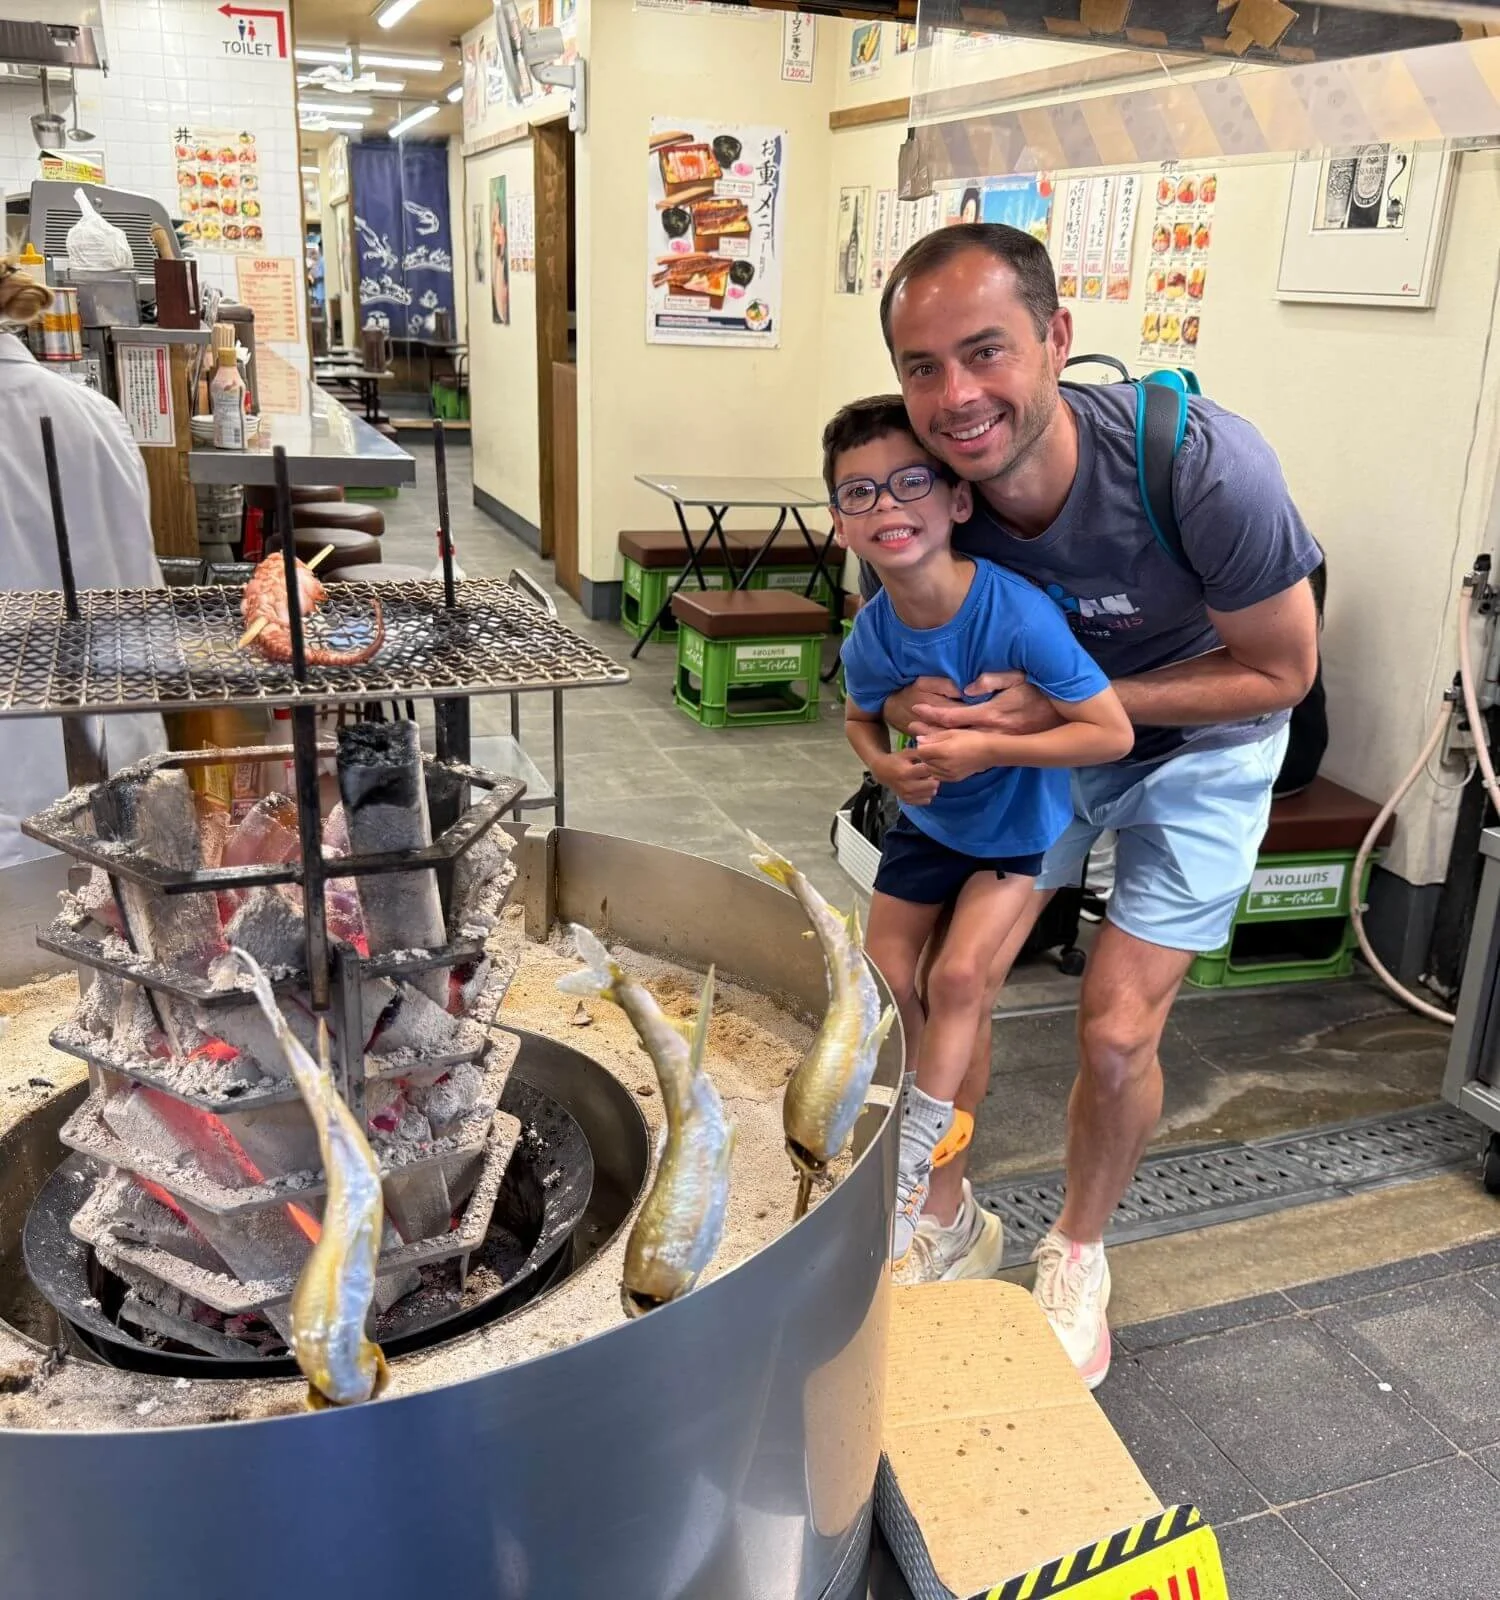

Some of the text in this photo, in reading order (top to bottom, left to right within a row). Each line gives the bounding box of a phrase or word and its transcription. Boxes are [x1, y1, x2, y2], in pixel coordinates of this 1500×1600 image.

[222, 41, 272, 56] TOILET
[754, 139, 777, 253] お重メニュー
[253, 260, 279, 270] ODEN
[1264, 871, 1330, 886] SUNTORY
[1283, 890, 1325, 905] サントリー
